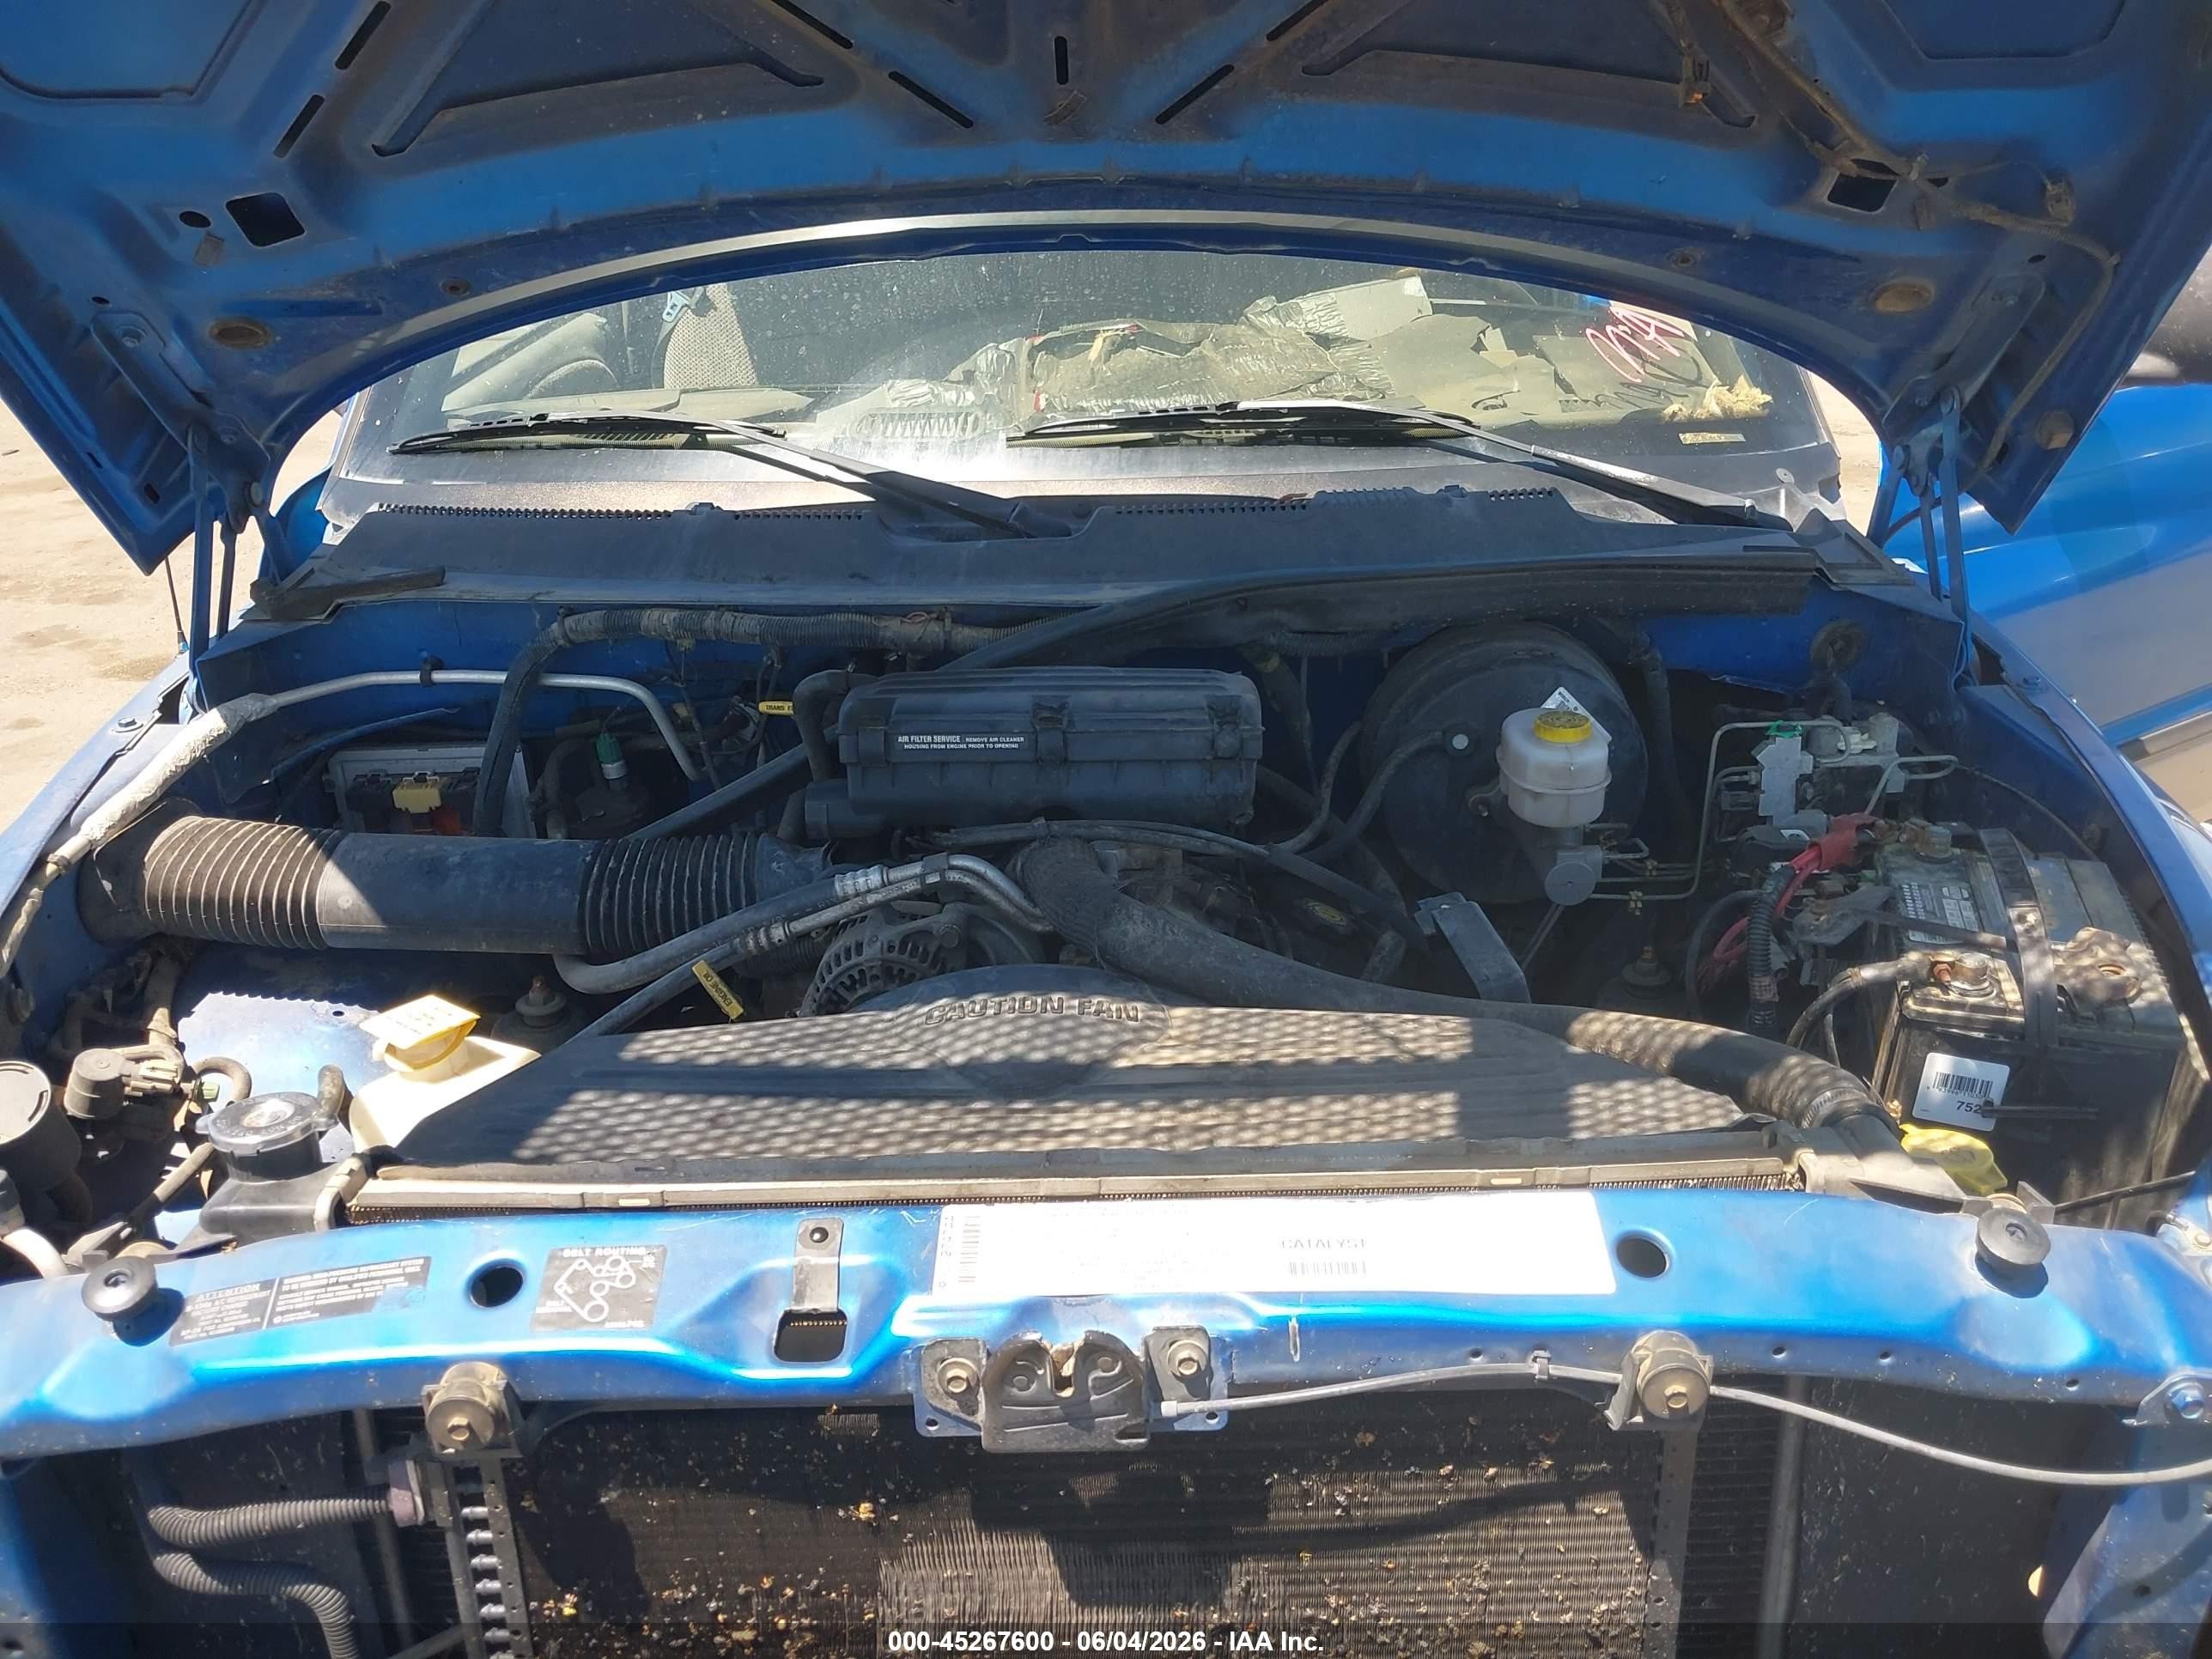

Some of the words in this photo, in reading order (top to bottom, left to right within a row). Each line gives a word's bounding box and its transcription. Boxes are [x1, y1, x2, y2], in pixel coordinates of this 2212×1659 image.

[710, 981, 733, 1006] ENGINE
[924, 995, 1064, 1026] CAUTION
[1077, 996, 1141, 1023] FAN
[1280, 1237, 1365, 1249] CATALYST
